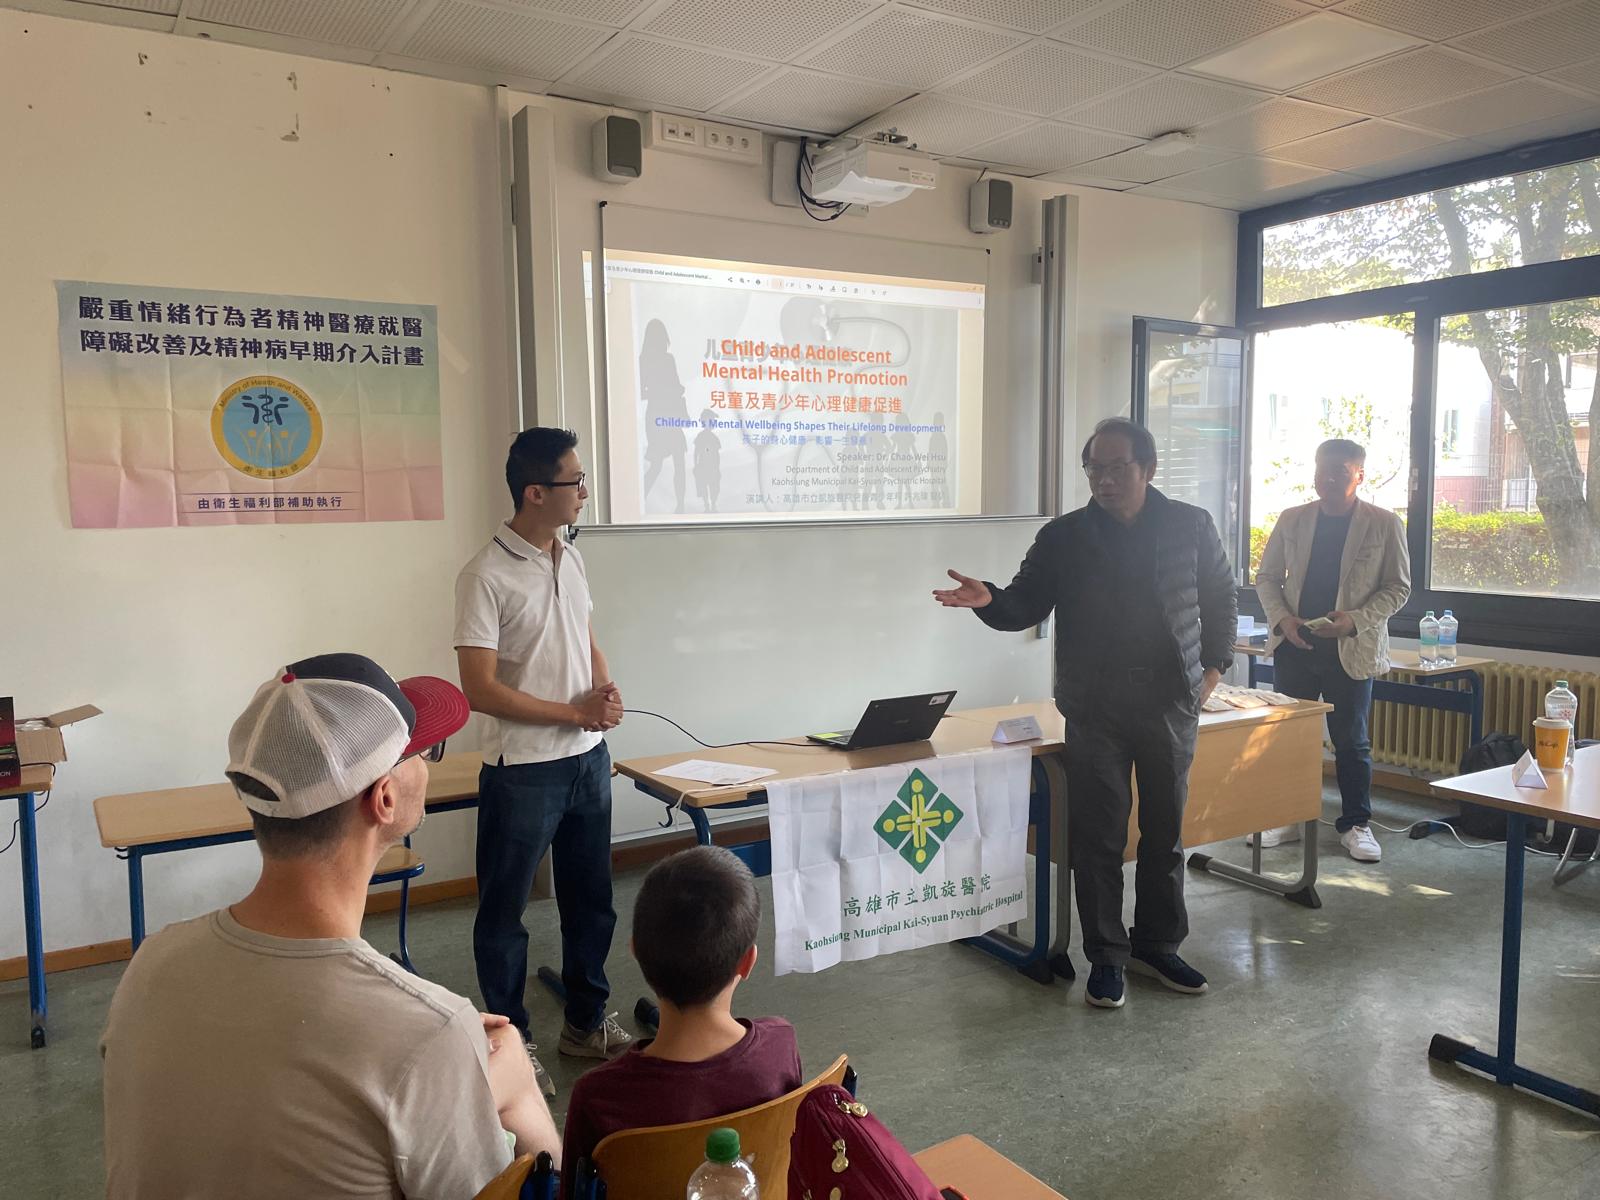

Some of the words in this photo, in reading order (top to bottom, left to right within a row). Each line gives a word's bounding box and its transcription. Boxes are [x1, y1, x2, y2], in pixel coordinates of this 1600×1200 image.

[78, 295, 423, 338] 嚴重情緒行為者精神醫療就醫
[80, 329, 424, 366] 障礙改善及精神病早期介入計畫
[721, 338, 765, 358] Child
[769, 343, 800, 359] and
[806, 345, 891, 363] Adolescent
[702, 362, 763, 380] Mental
[768, 366, 822, 383] Health
[827, 369, 908, 386] Promotion
[710, 390, 902, 413] 兒童及青少年心理健康促進
[655, 417, 706, 429] Children's
[709, 418, 743, 429] Mental
[745, 420, 792, 432] Wellbeing
[793, 421, 826, 432] Shapes
[828, 422, 850, 431] Their
[852, 422, 887, 433] Lifelong
[786, 465, 830, 475] Department
[198, 495, 343, 510] 由衛生福利部補助執行
[844, 873, 992, 918] 高雄市立凱旋醫院
[805, 930, 851, 951] Kaohsiung
[853, 921, 901, 939] Municipal
